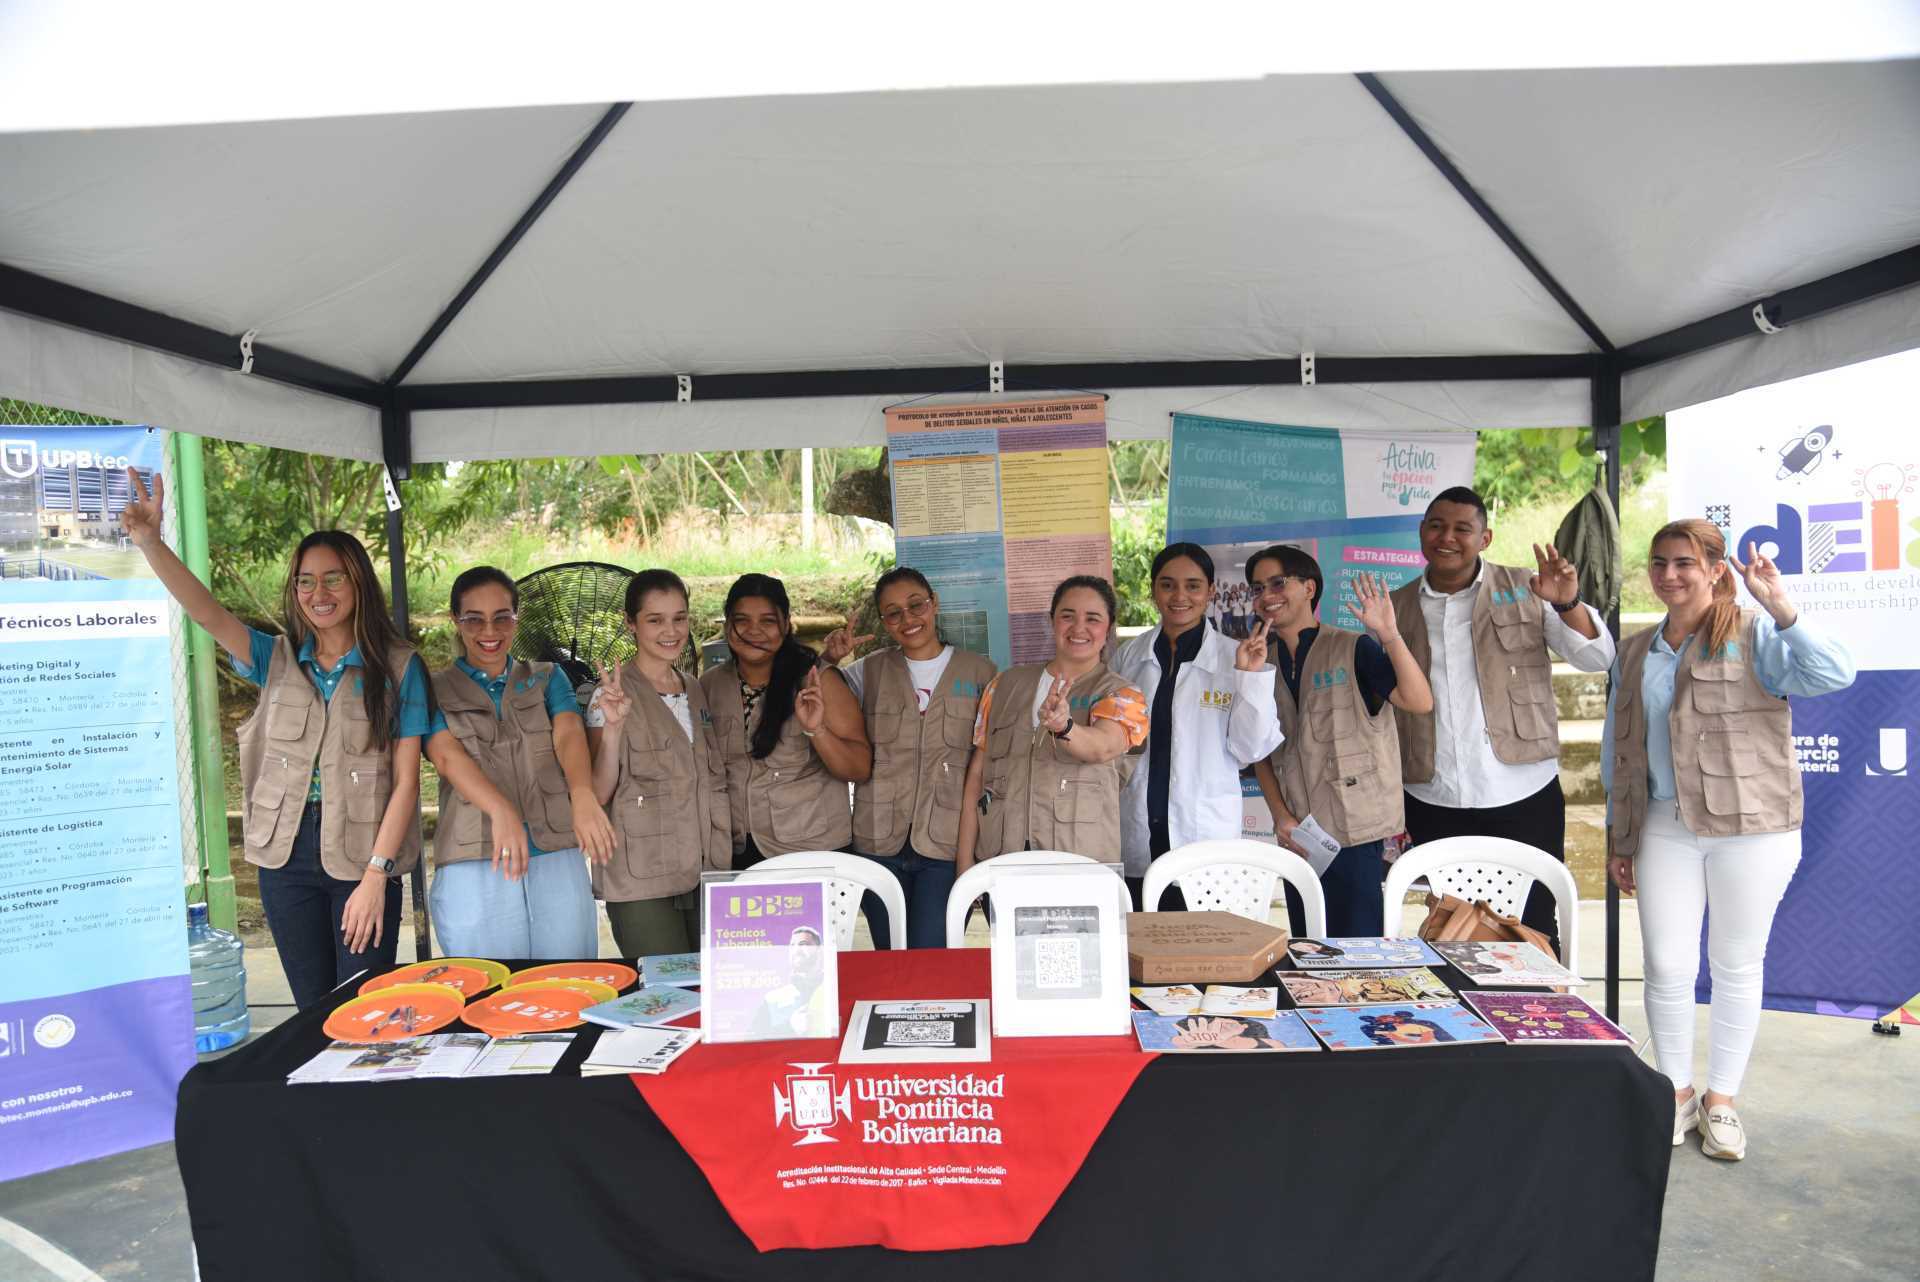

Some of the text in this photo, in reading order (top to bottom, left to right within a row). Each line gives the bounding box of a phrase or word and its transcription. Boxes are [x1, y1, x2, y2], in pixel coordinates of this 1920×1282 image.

[898, 413, 929, 421] PROTOCOLO
[956, 418, 982, 426] SEXUALES
[1032, 413, 1073, 422] ADOLESCENTES
[42, 450, 129, 469] UPBtec
[1382, 441, 1437, 472] Activa
[1262, 468, 1337, 485] FORMAMOS
[1172, 505, 1265, 521] ACOMPAÑAMOS
[1353, 550, 1420, 564] ESTRATEGIAS
[0, 612, 158, 629] Técnicos Laborales
[0, 660, 81, 672] keting Digital y
[0, 670, 117, 684] tión de Redes Sociales
[0, 731, 161, 749] stente en Instalación y
[1791, 734, 1839, 746] ara de
[0, 745, 129, 762] ntenimiento de Sistemas
[1795, 746, 1839, 760] ercio
[1, 762, 73, 776] Energía Solar
[1800, 760, 1840, 773] ntería
[0, 826, 39, 838] sistente
[41, 824, 54, 833] de
[46, 886, 59, 895] en
[62, 875, 133, 891] Programación
[12, 898, 59, 912] Software
[714, 928, 767, 940] Técnicos
[715, 938, 775, 950] Laborales
[1188, 1032, 1219, 1041] STOP
[855, 1073, 1005, 1100] Universidad
[1, 1085, 83, 1109] con nosotros
[877, 1096, 994, 1120] Pontificia
[862, 1119, 1002, 1145] Bolivariana
[776, 1164, 1007, 1178] Acreditación Institucional de Alta Calidad Sede Central Medellín
[831, 1175, 840, 1183] del
[849, 1177, 857, 1185] de
[857, 1177, 880, 1186] febrero
[880, 1178, 889, 1187] de
[958, 1175, 1002, 1185] Mineducación
